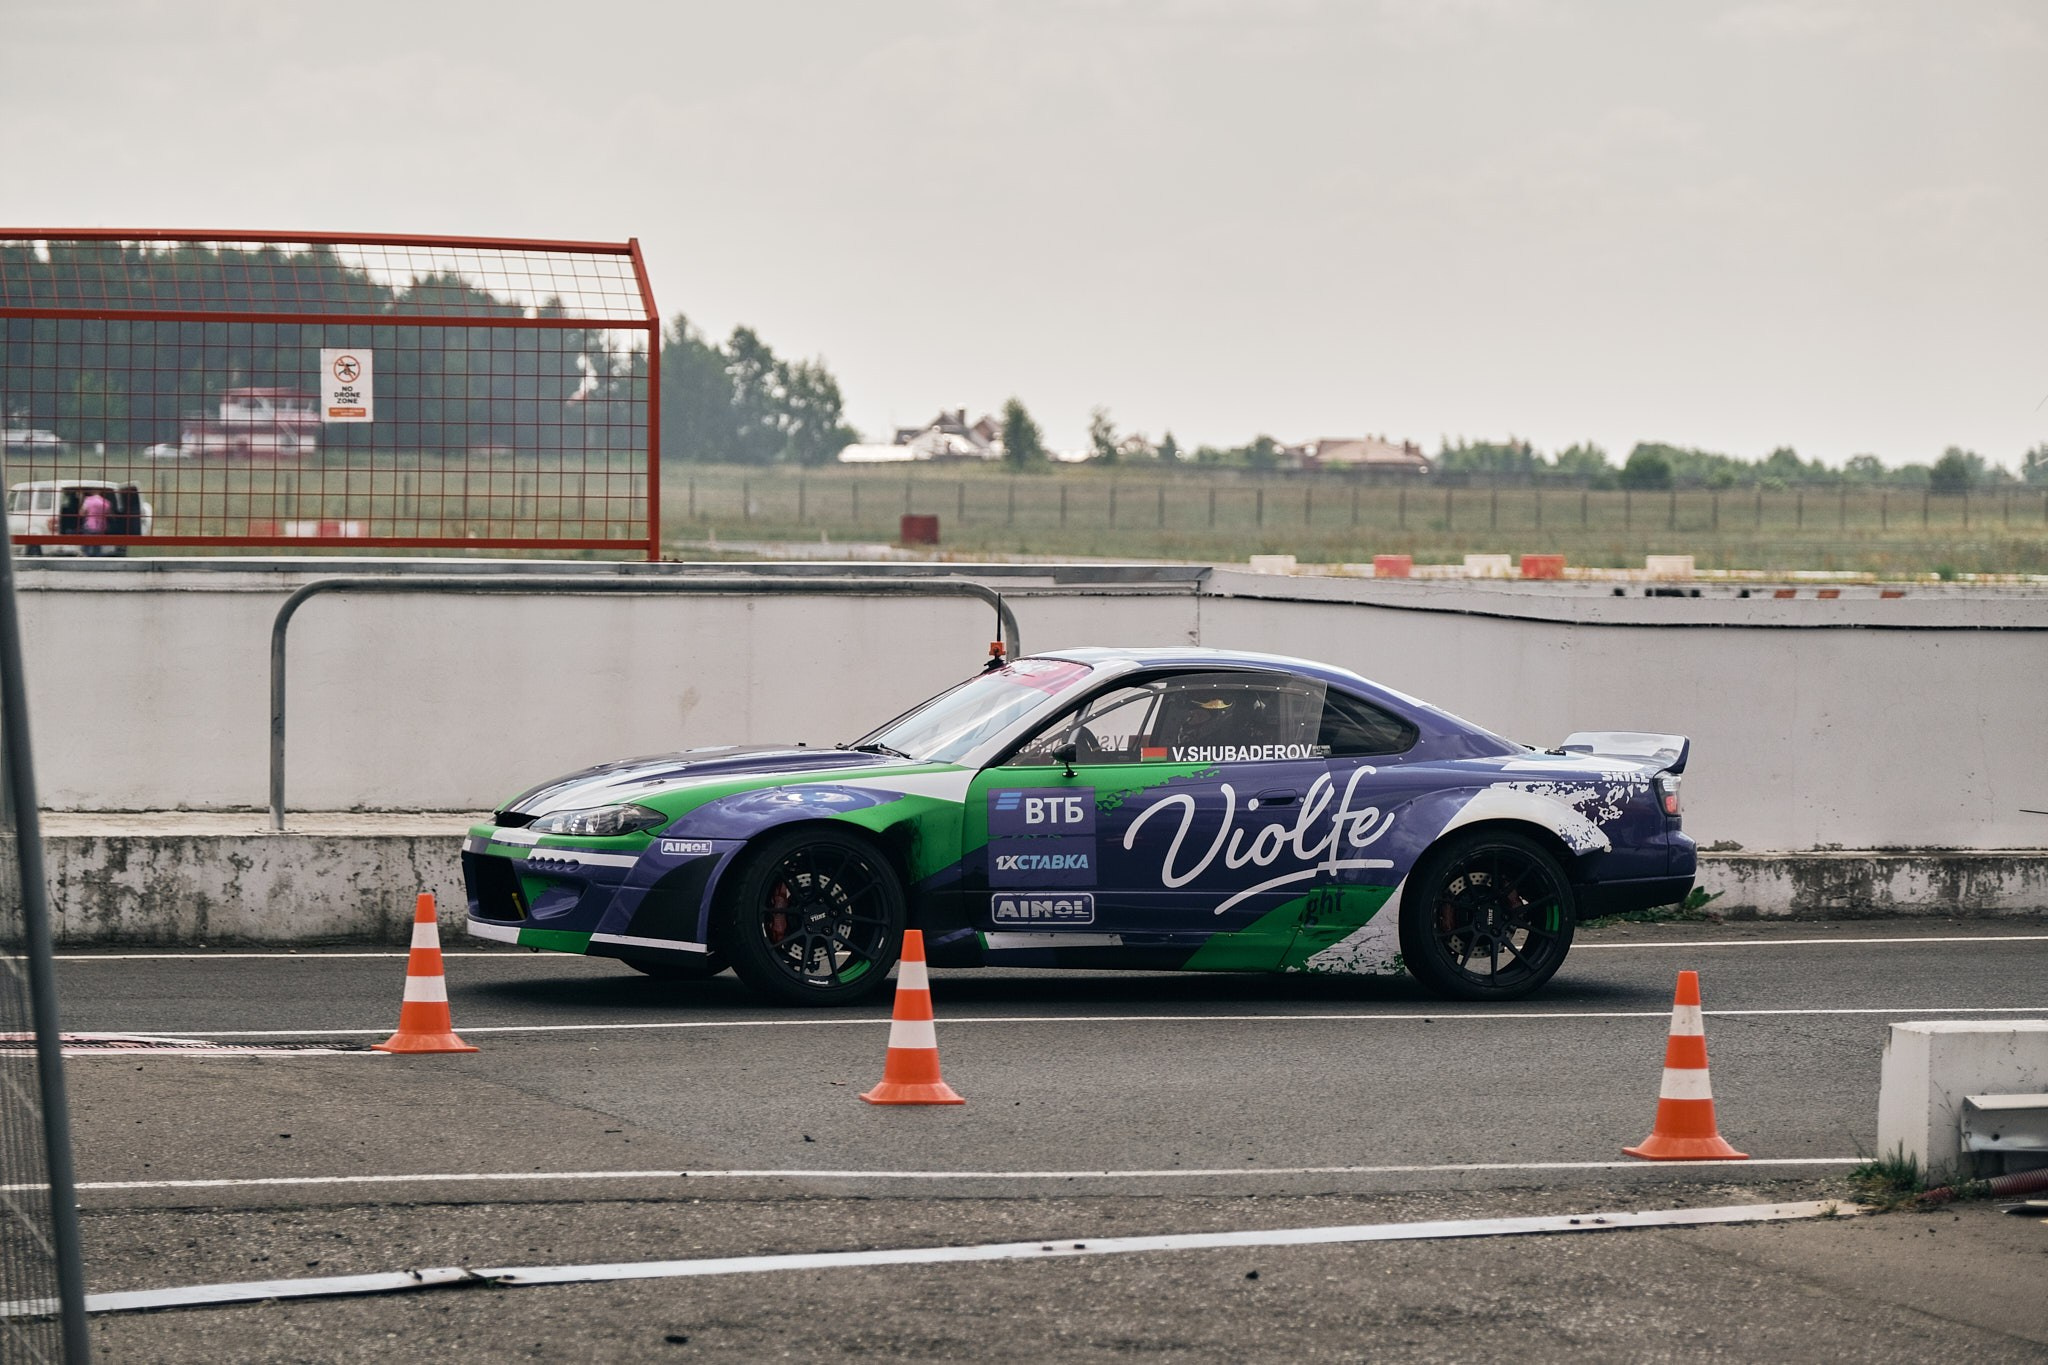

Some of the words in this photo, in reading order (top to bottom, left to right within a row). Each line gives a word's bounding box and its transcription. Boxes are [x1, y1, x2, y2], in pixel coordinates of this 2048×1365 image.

[1172, 743, 1313, 762] V.SHUBADEROV
[1600, 771, 1650, 783] SKILL
[1025, 796, 1084, 824] ВТБ
[663, 842, 709, 853] AIMOL
[996, 900, 1090, 918] AIMOL
